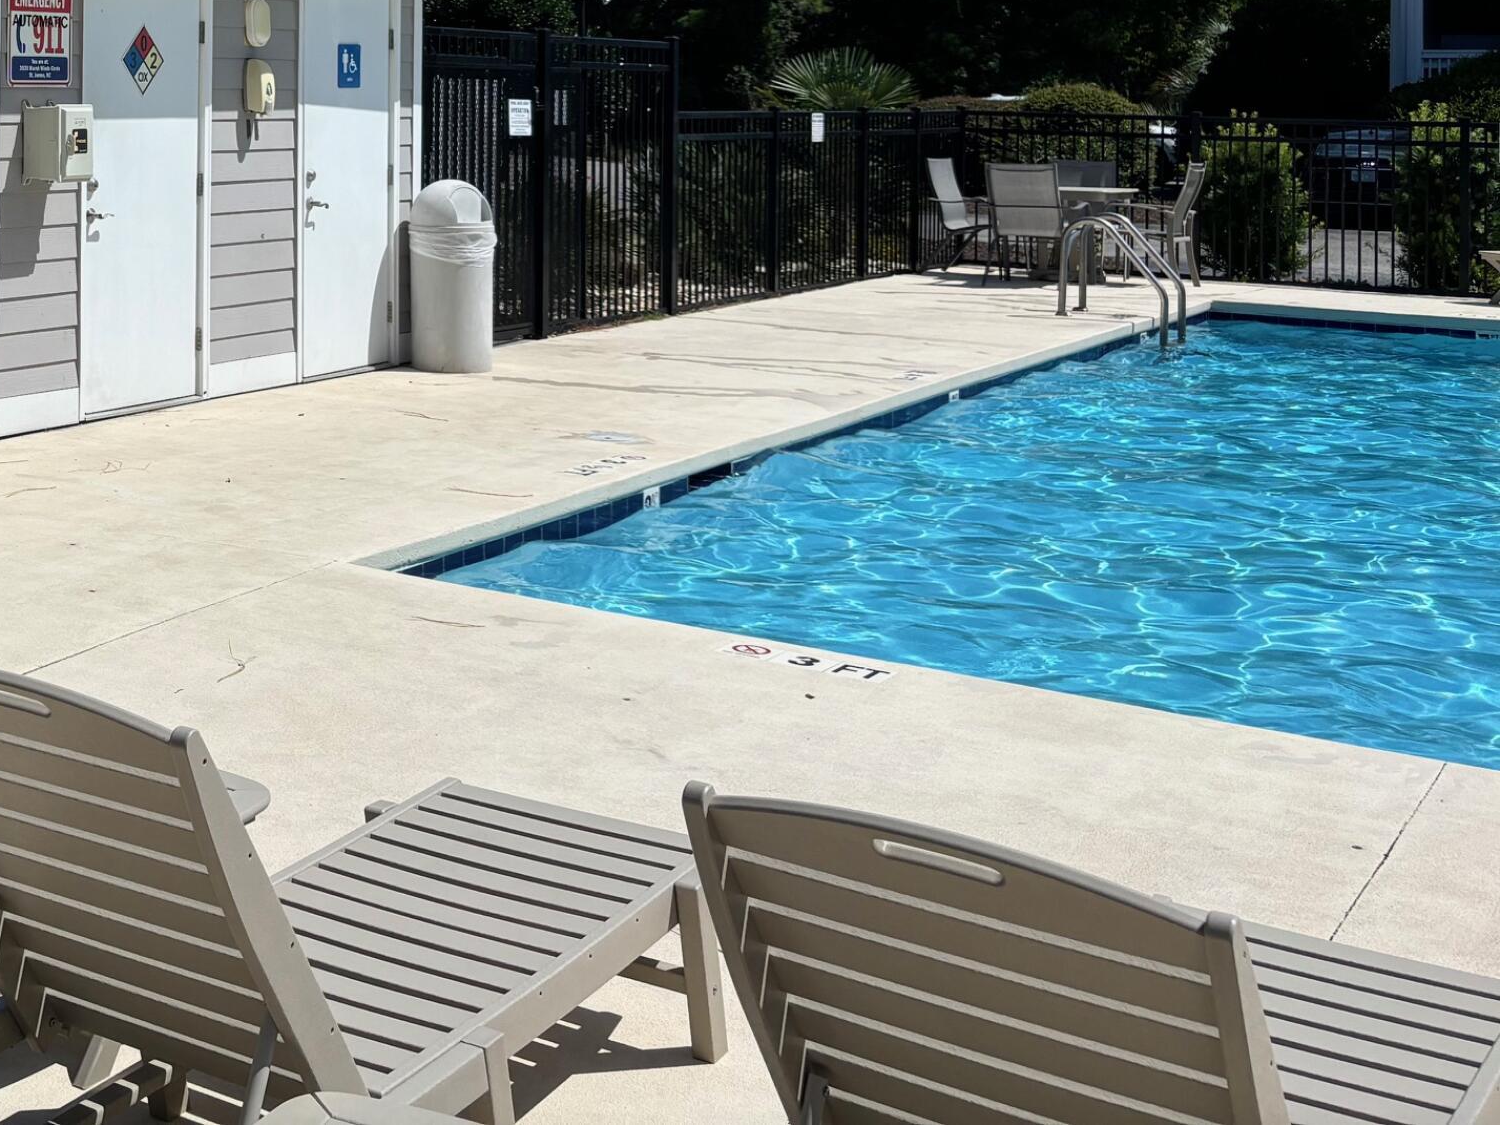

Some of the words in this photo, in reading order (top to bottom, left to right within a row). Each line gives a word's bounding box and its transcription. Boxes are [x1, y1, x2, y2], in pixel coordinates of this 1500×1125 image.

[12, 14, 68, 29] AUTOMATIC
[32, 16, 65, 54] 911
[140, 35, 148, 52] 0
[129, 51, 137, 69] 3
[149, 52, 158, 69] 2
[137, 71, 149, 83] OX
[787, 655, 821, 667] 3
[831, 663, 891, 680] FT
